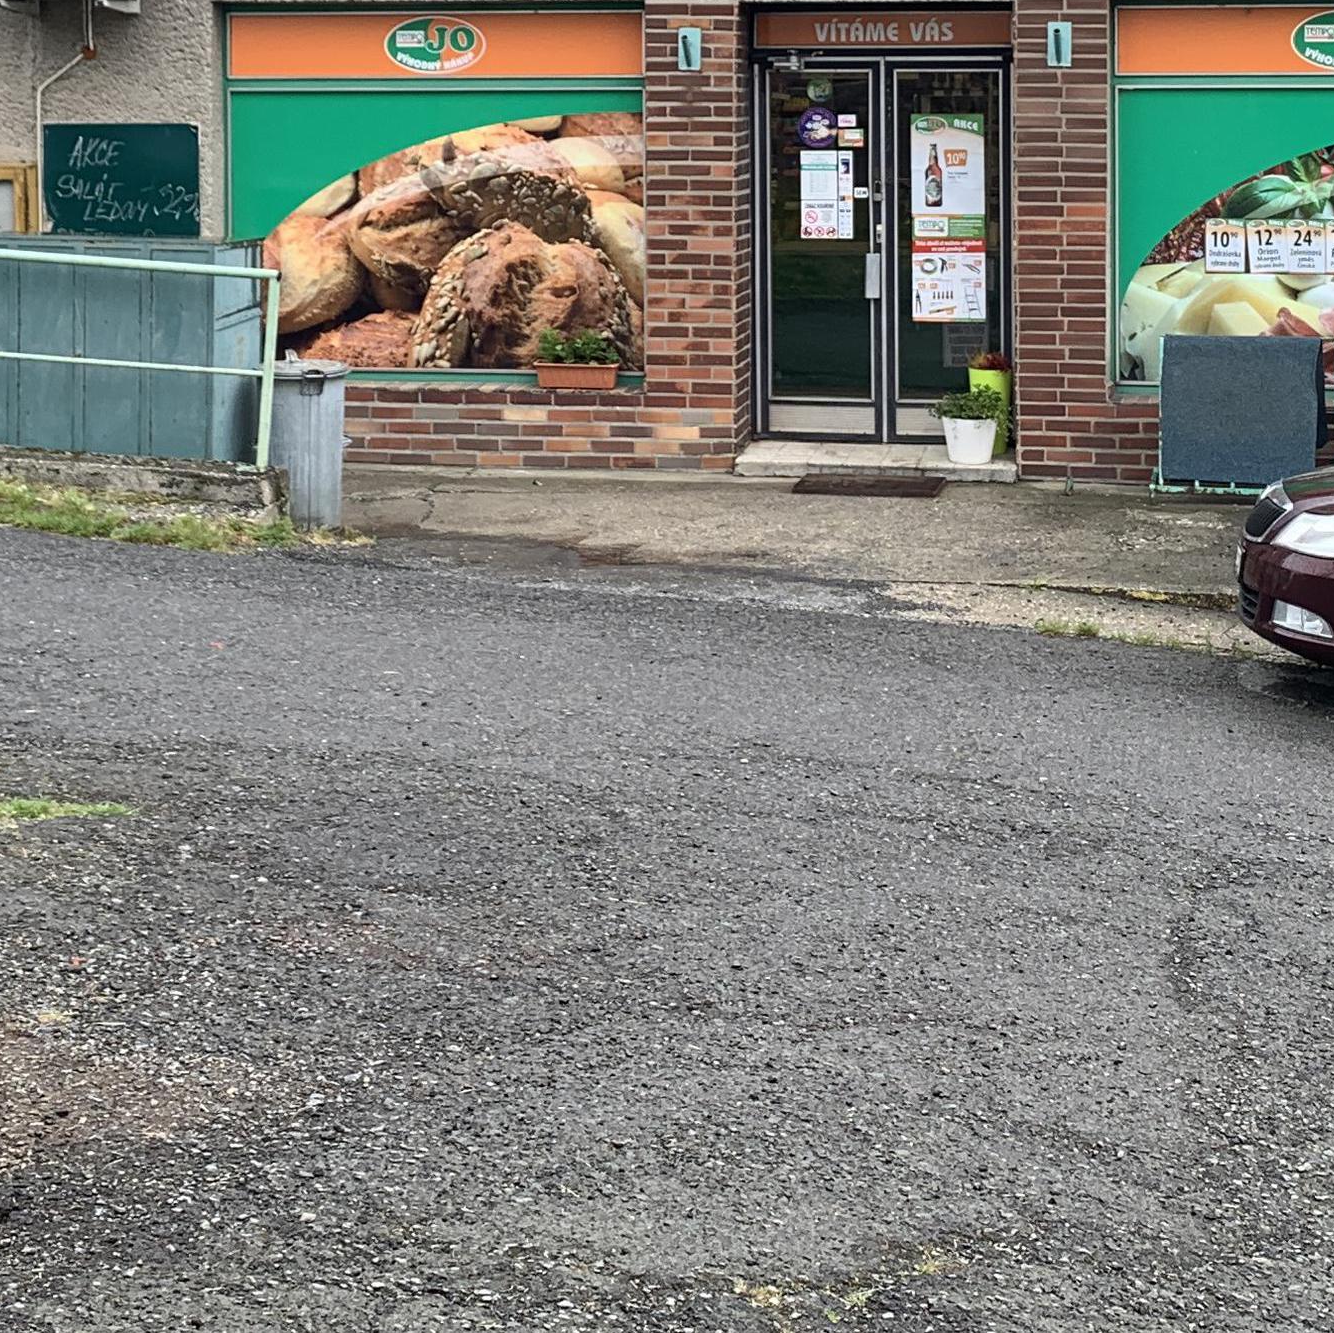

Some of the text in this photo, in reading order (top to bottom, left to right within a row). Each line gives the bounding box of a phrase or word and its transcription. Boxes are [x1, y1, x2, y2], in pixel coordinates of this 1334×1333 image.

[814, 17, 954, 42] VÍTÁME VÁS
[426, 25, 476, 53] JO
[954, 119, 978, 130] AKCE
[69, 136, 125, 170] AKCE
[947, 153, 959, 165] 10
[1211, 231, 1230, 247] 10
[1255, 229, 1273, 246] 12
[1294, 230, 1312, 246] 24
